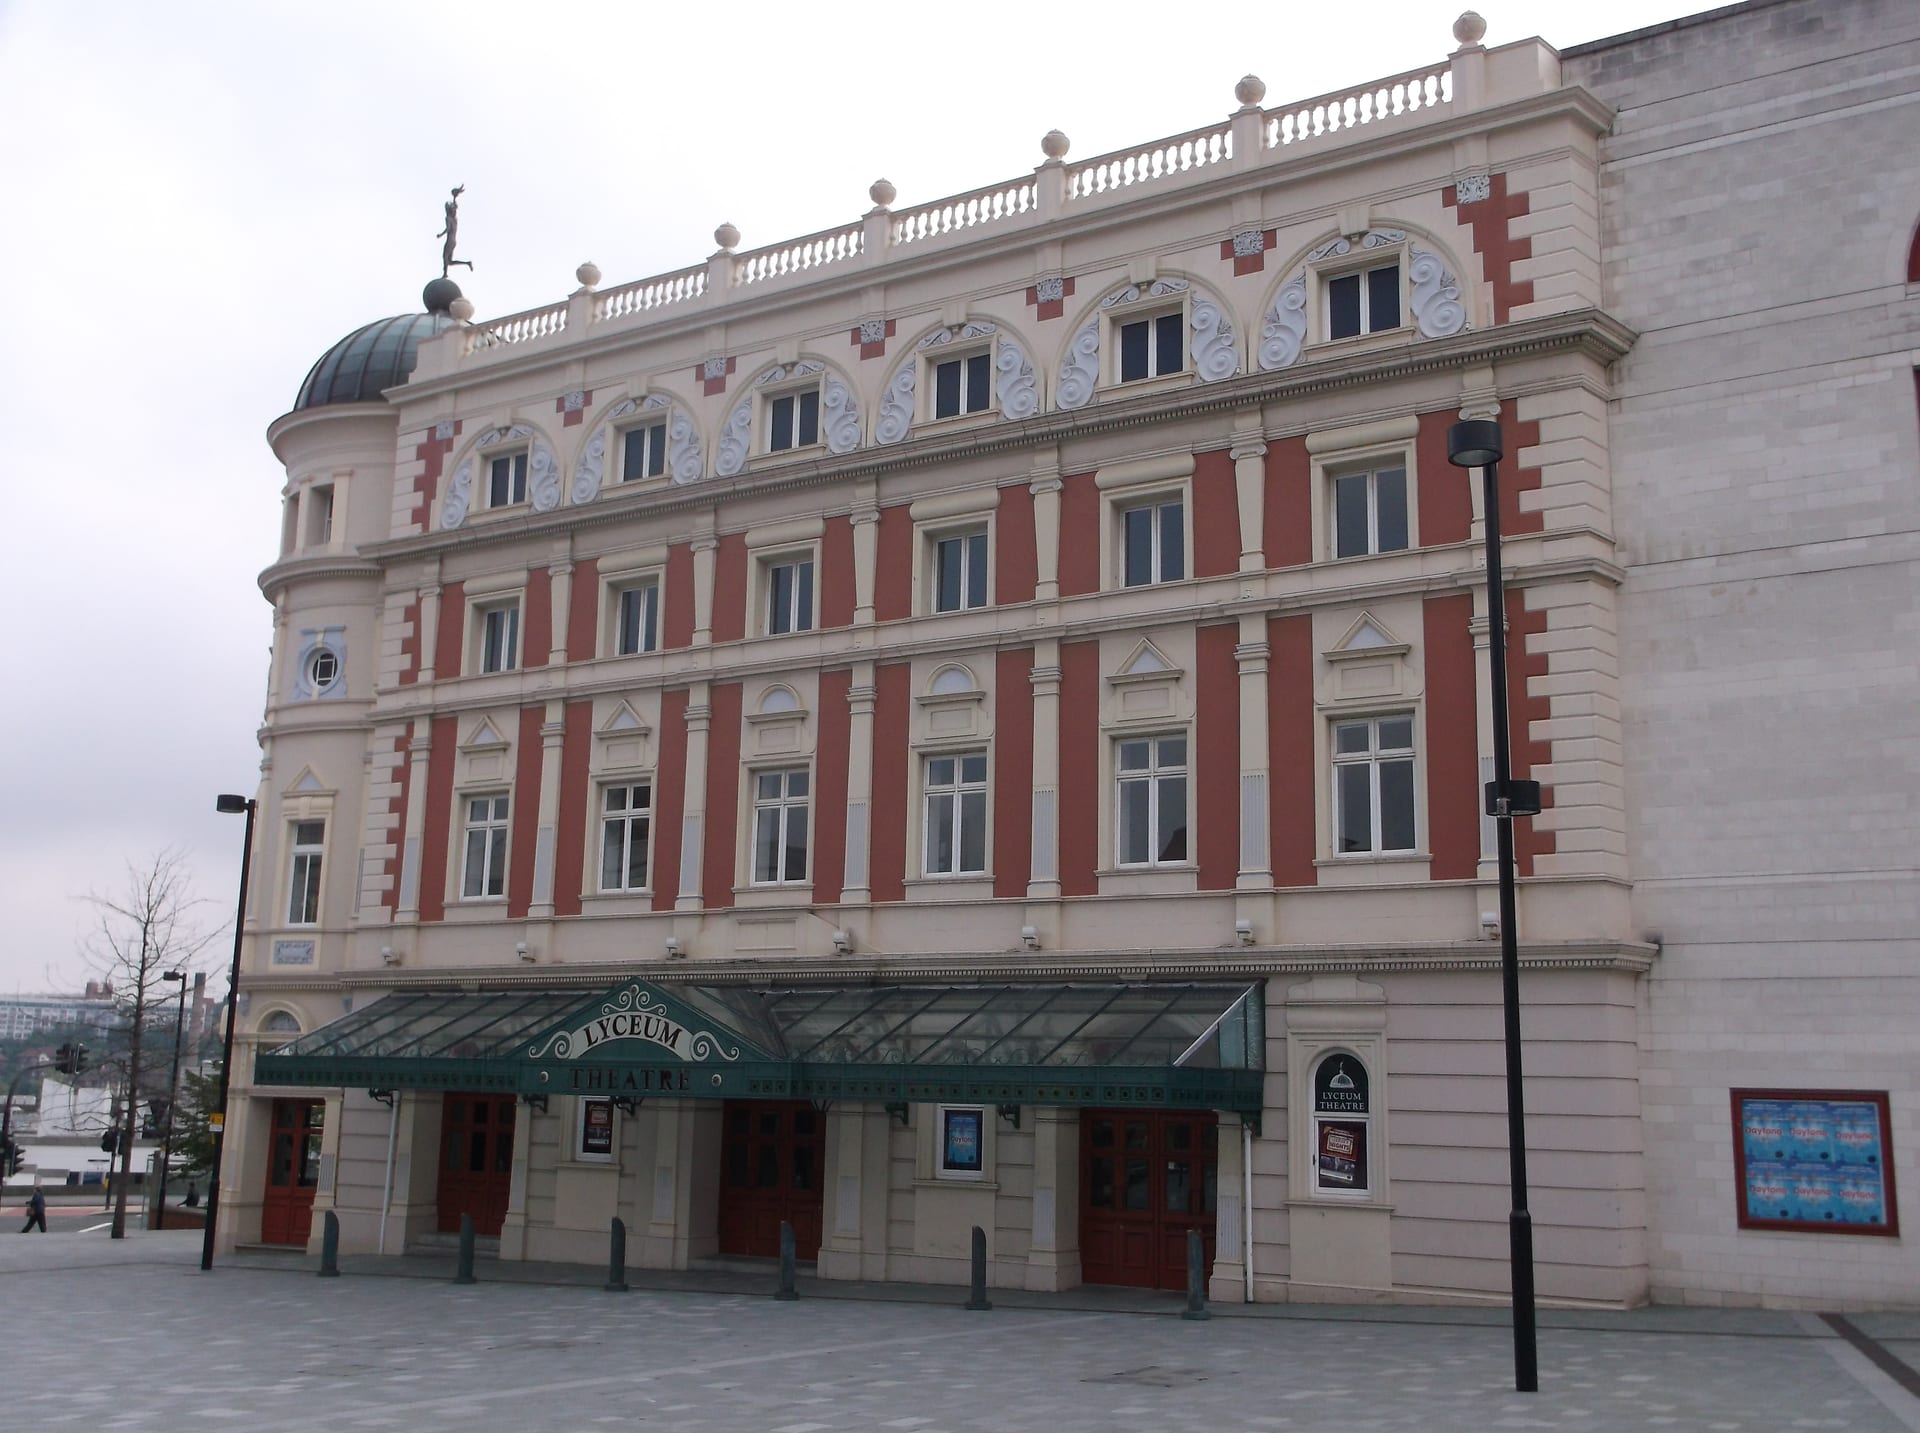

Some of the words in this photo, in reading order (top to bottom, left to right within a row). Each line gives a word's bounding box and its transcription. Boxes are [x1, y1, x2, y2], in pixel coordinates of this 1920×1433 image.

[584, 1015, 682, 1049] LYCEUM
[570, 1069, 690, 1090] THEATRE
[1322, 1092, 1361, 1101] LYCEUM
[1320, 1102, 1364, 1110] THEATRE
